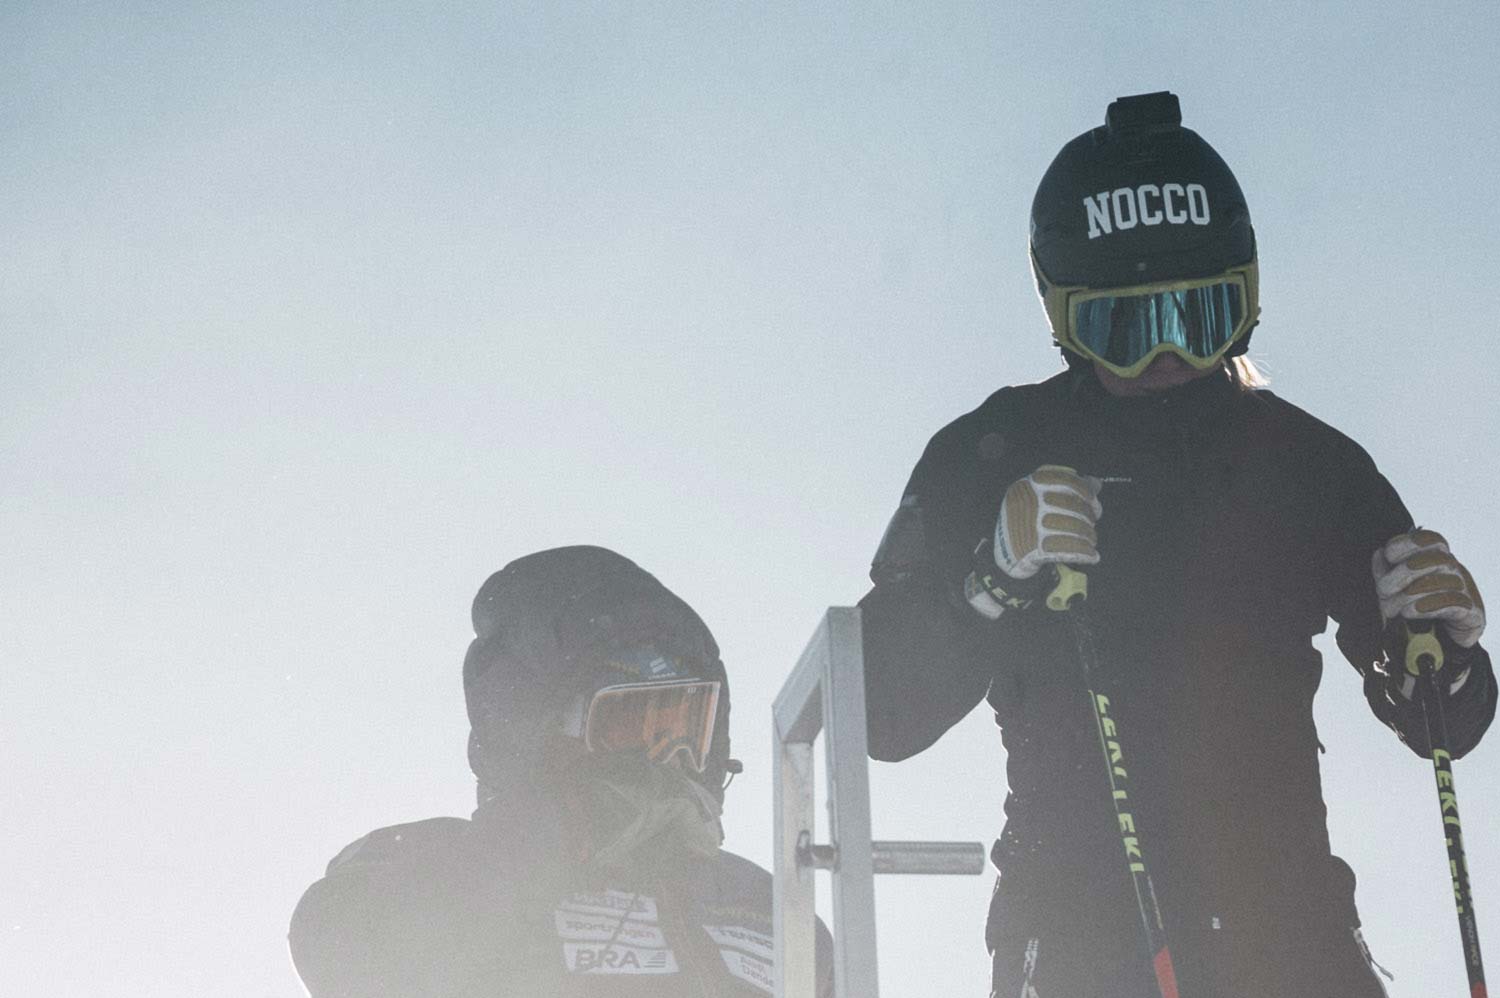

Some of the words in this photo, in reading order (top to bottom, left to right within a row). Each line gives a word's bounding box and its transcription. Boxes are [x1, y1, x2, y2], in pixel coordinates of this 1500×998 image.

[1083, 184, 1211, 239] NOCCO
[1433, 748, 1461, 828] LEKI
[565, 920, 656, 940] sportrngen
[575, 948, 641, 969] BRA
